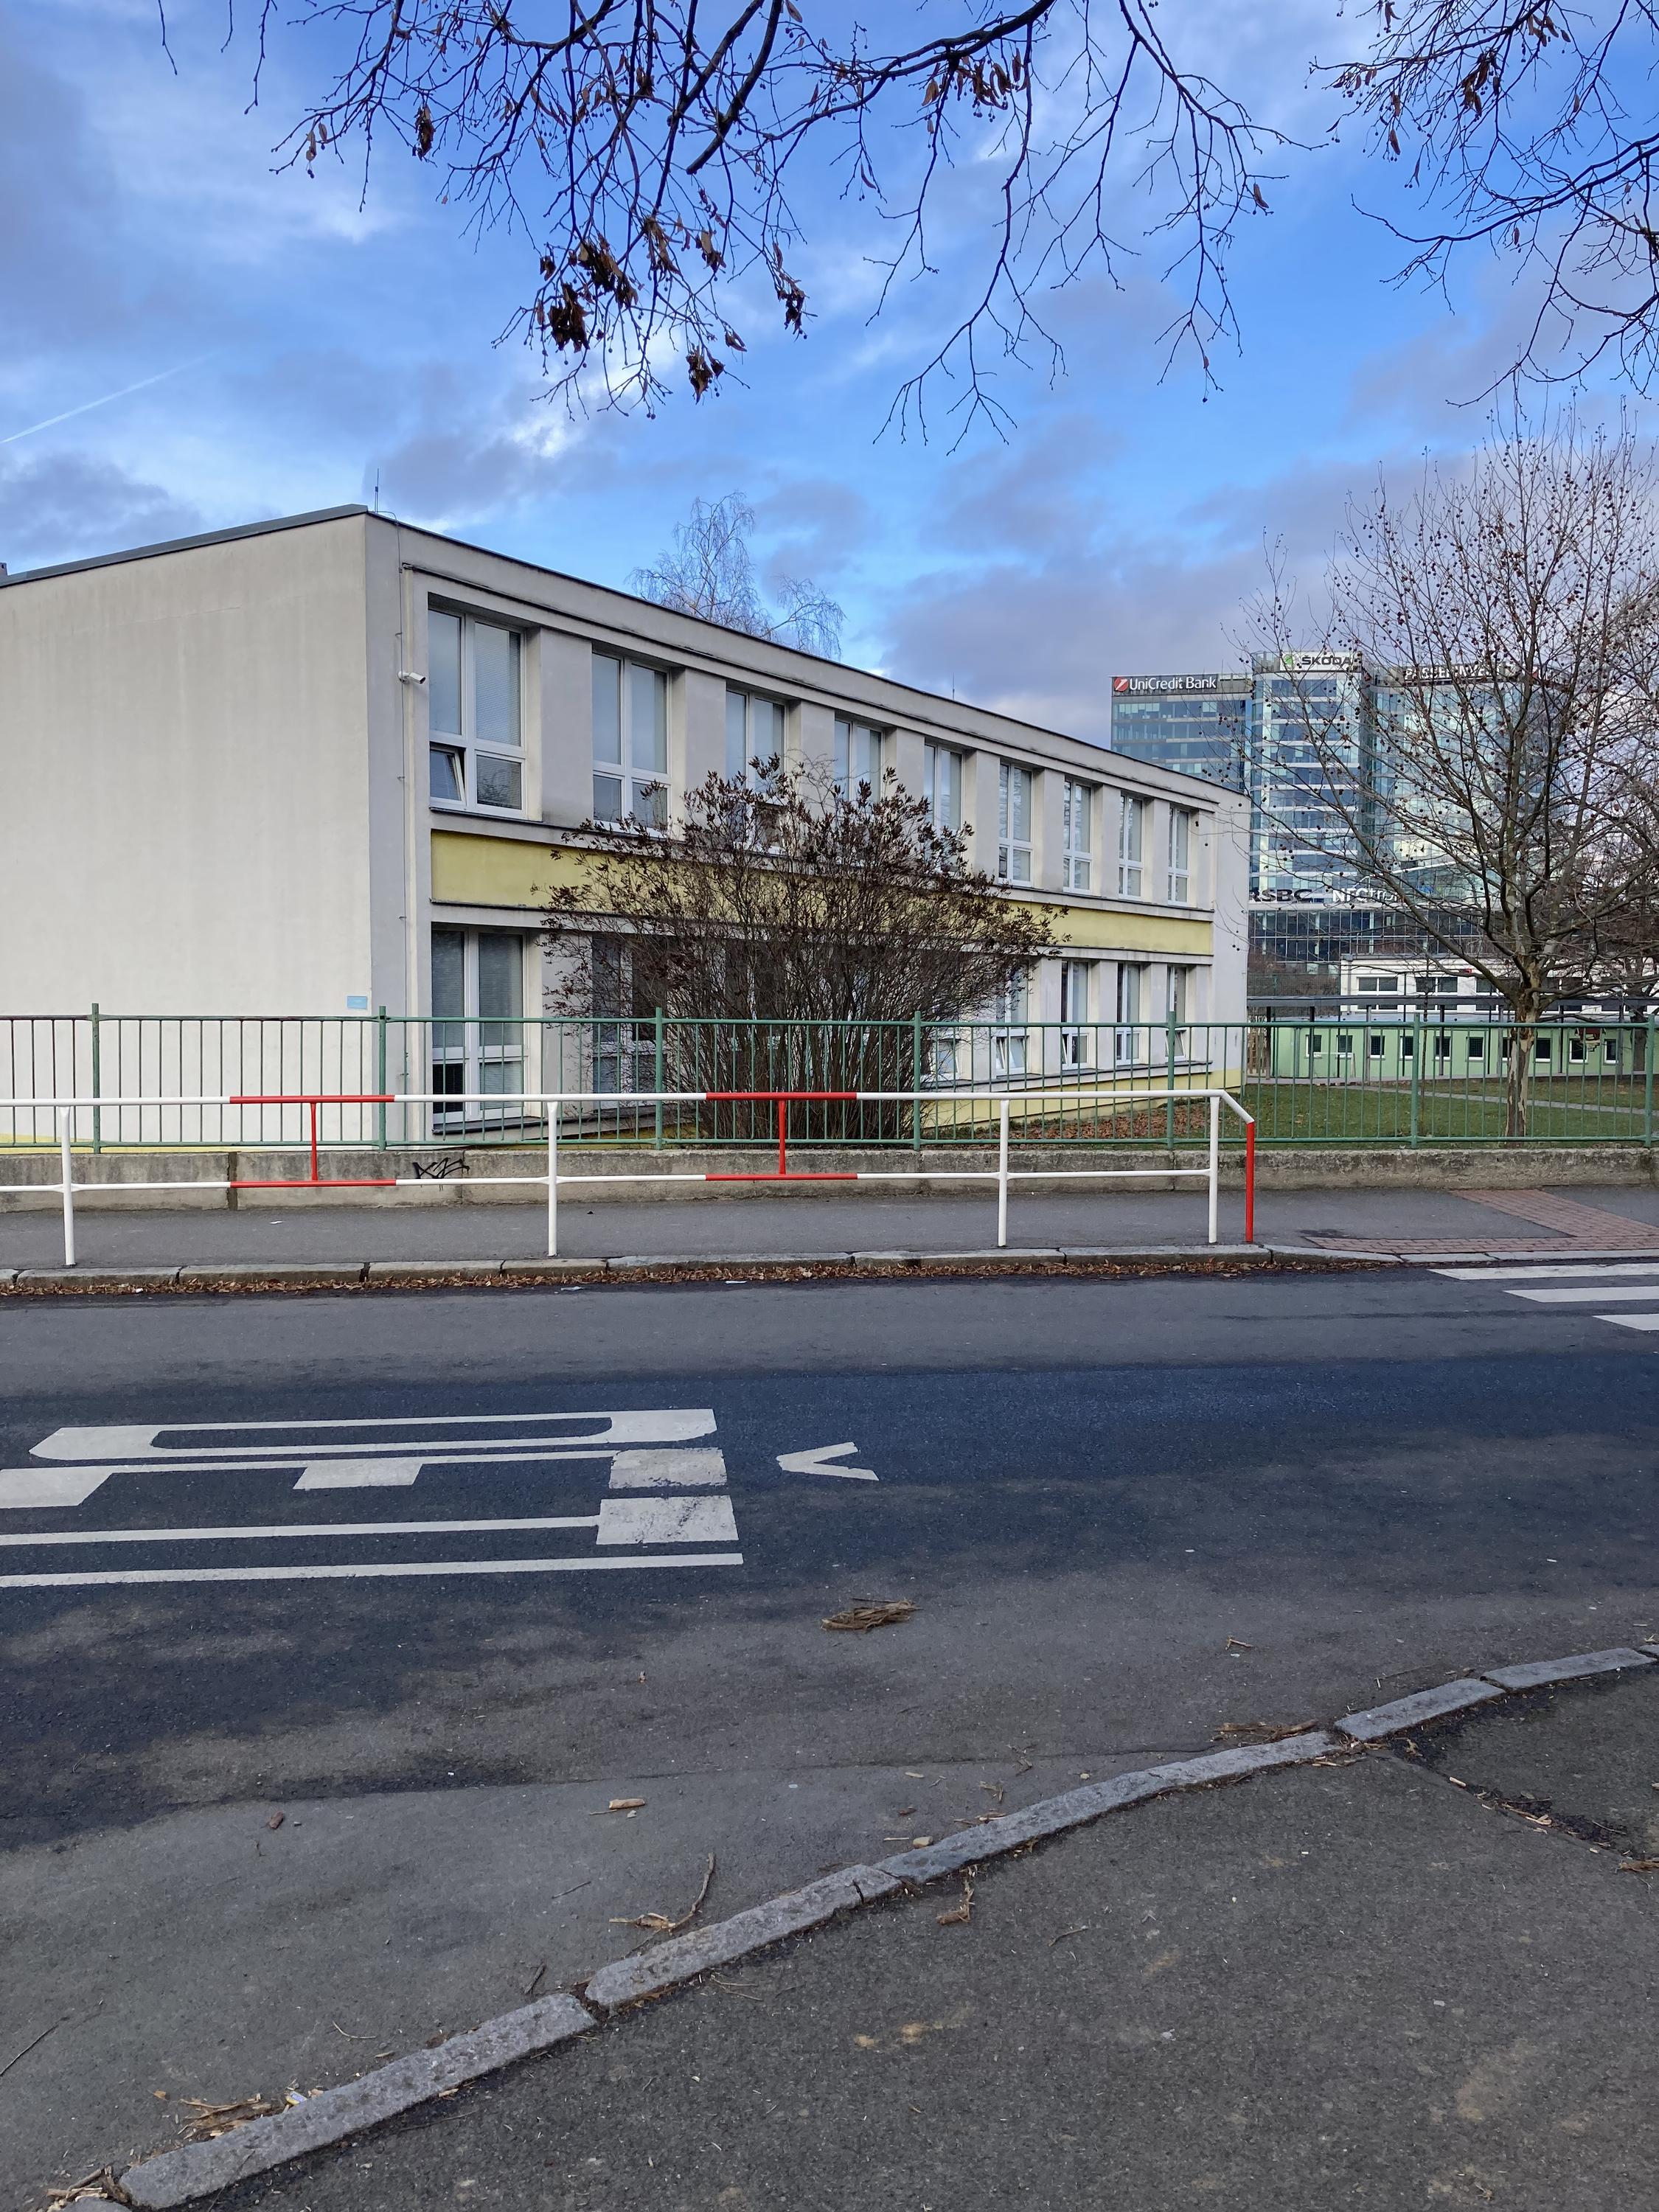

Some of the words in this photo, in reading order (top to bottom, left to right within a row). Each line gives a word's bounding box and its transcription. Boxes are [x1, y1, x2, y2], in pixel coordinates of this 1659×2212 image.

[1302, 655, 1351, 666] ŠKODA
[1130, 677, 1183, 690] UniCredit
[1186, 676, 1217, 689] Bank
